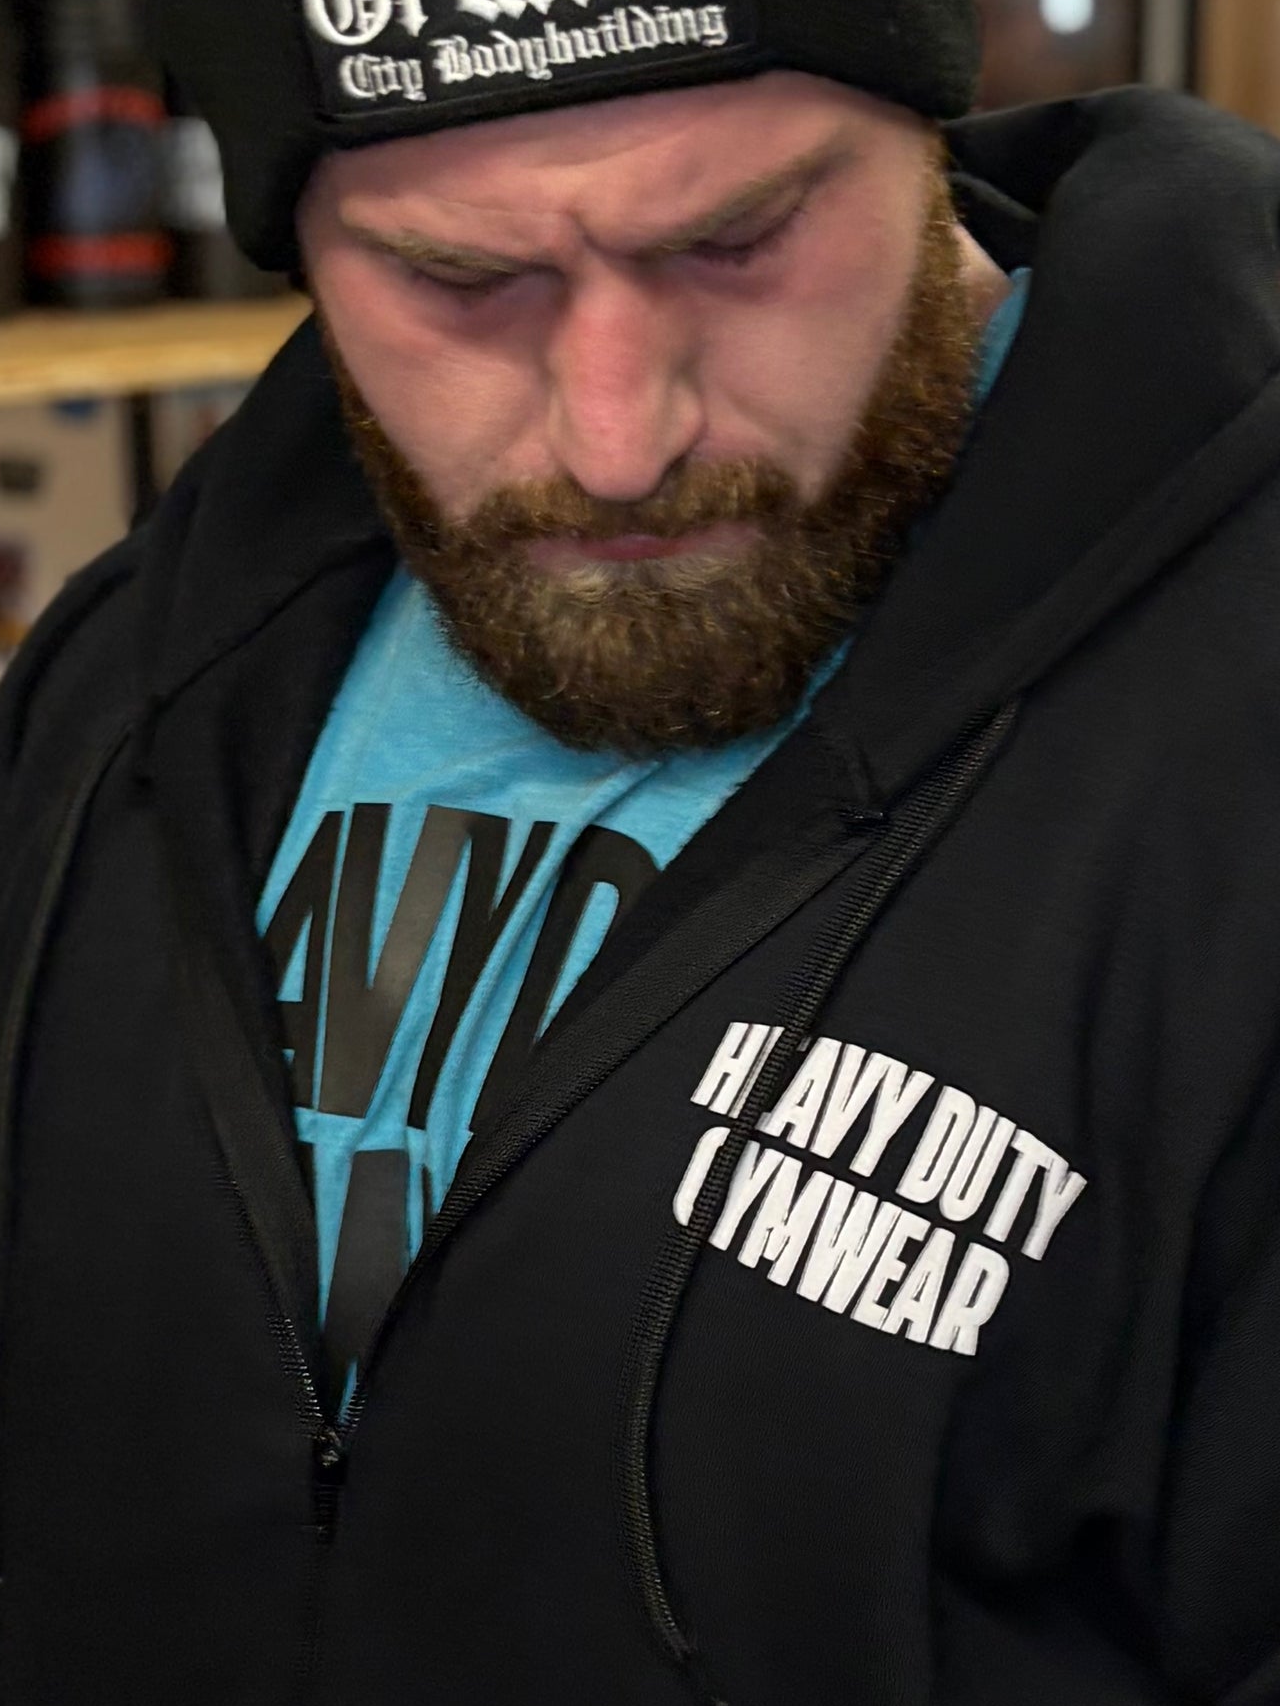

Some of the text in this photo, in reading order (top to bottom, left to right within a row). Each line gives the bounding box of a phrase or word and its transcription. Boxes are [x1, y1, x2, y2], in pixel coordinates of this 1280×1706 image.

[339, 4, 730, 102] City Bodybuilding
[690, 1021, 1088, 1262] HAVY DUTY
